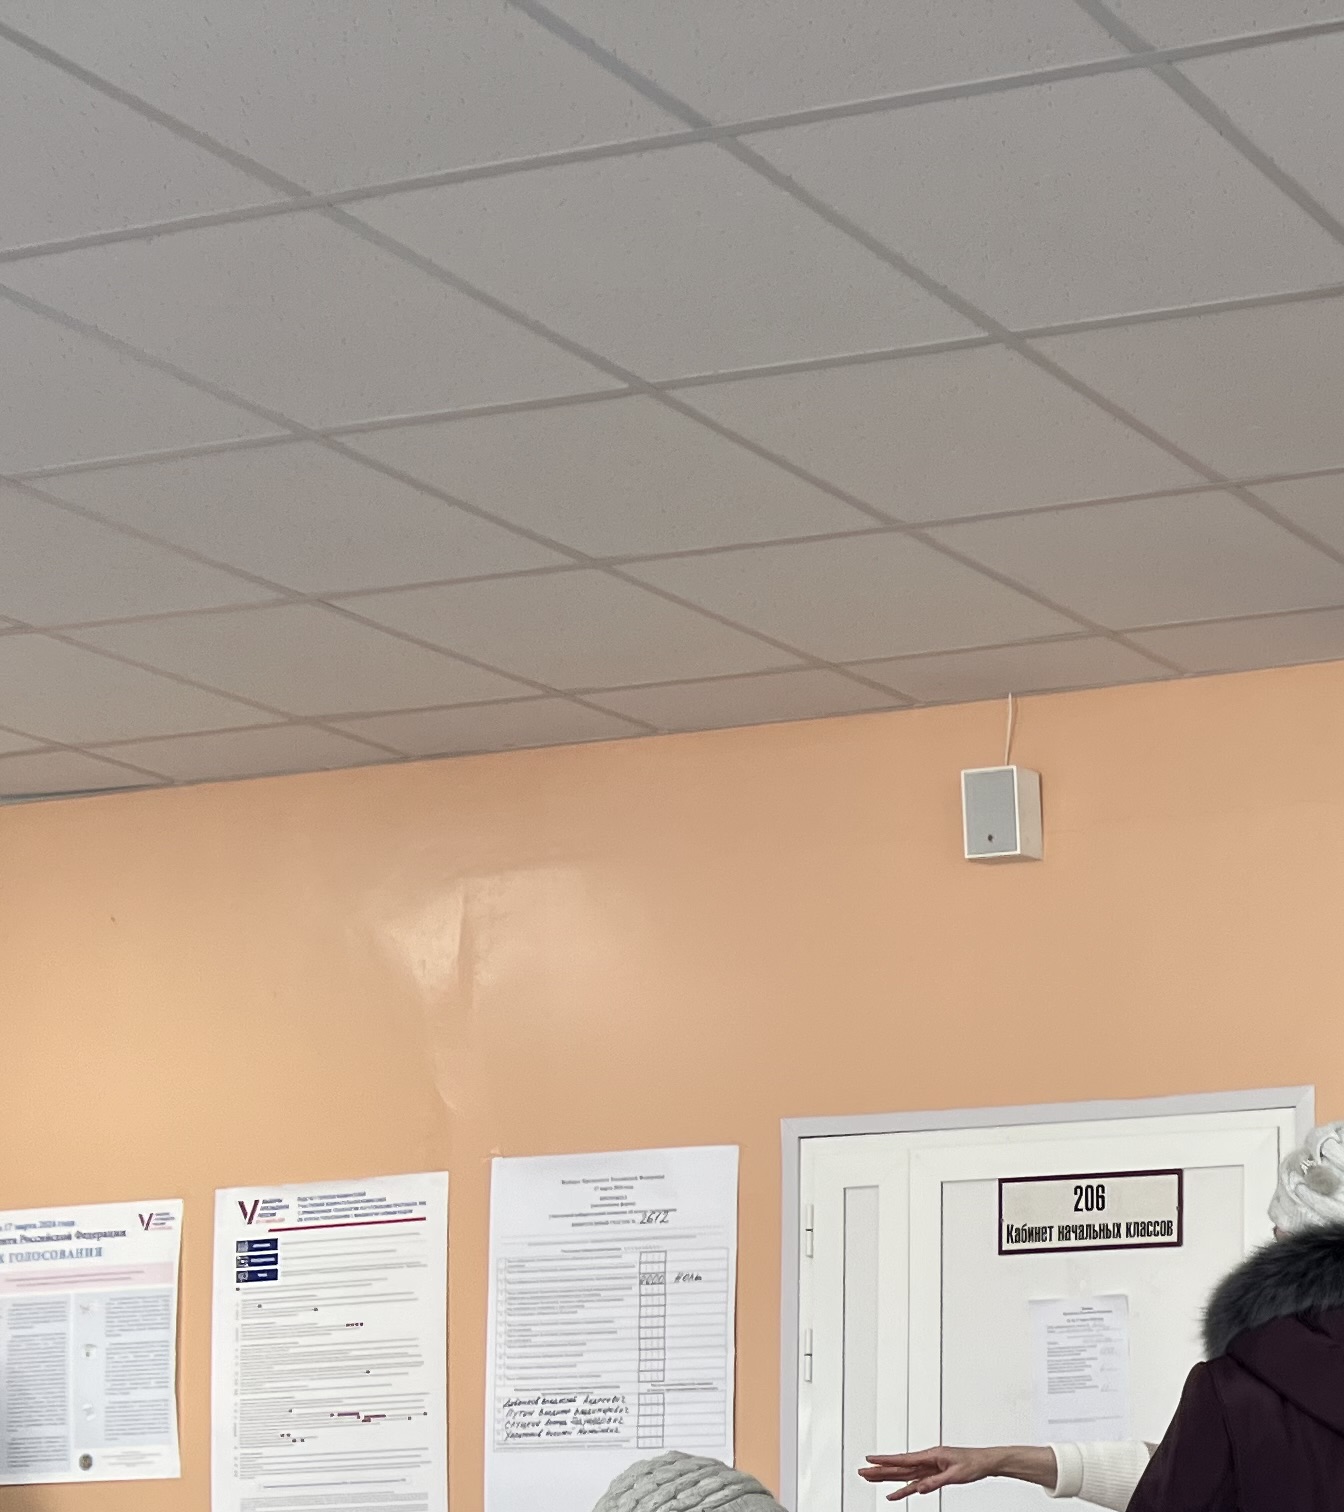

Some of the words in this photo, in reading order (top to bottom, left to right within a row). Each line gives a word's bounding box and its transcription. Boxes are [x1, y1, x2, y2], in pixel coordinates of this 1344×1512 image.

[1073, 1184, 1106, 1212] 206
[1006, 1223, 1054, 1245] Кабинет
[1057, 1221, 1122, 1242] начальных
[1125, 1219, 1174, 1239] классов
